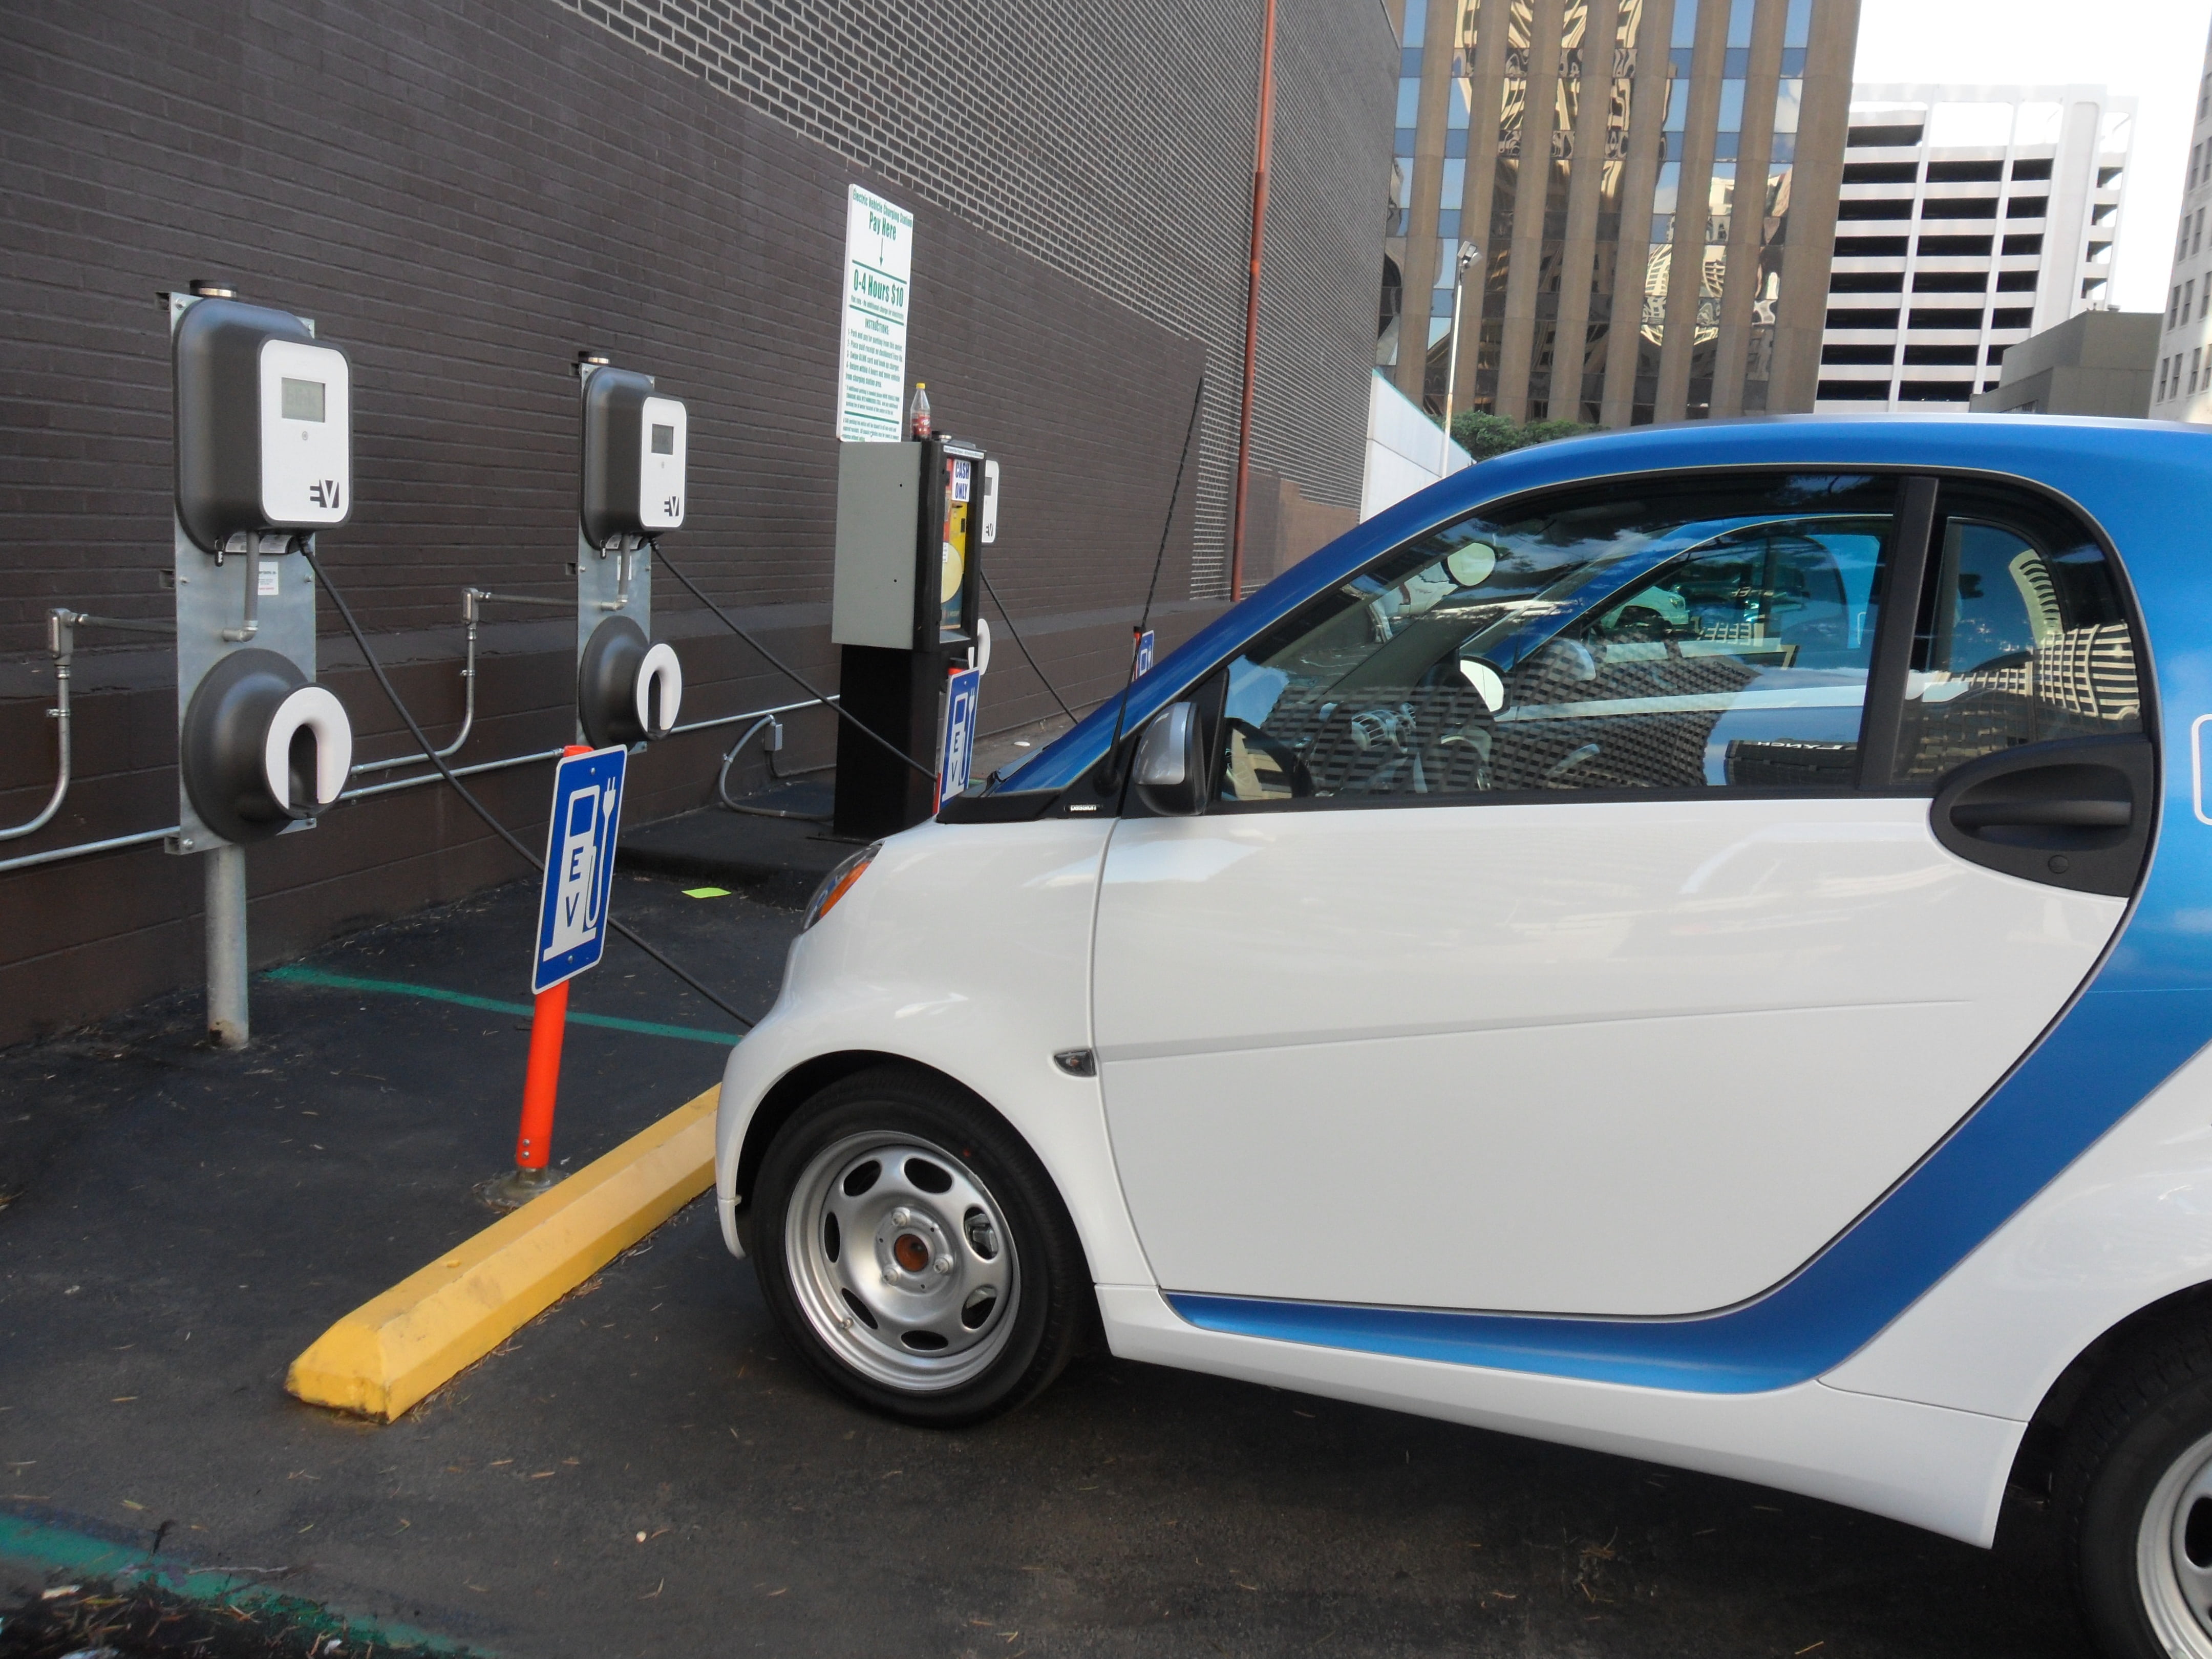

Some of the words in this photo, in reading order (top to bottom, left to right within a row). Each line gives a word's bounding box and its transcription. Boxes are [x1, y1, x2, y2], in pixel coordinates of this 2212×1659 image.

[853, 189, 867, 206] Electric
[869, 197, 882, 213] Vehicle
[884, 204, 899, 223] Charging
[869, 210, 881, 235] Pay
[882, 217, 896, 241] Here
[854, 269, 866, 294] 0-4
[868, 274, 889, 303] Hours
[891, 283, 904, 307] $10
[955, 462, 969, 479] CASH
[310, 479, 339, 508] EV
[955, 482, 968, 500] ONLY
[664, 496, 679, 517] EV
[986, 523, 993, 537] EV
